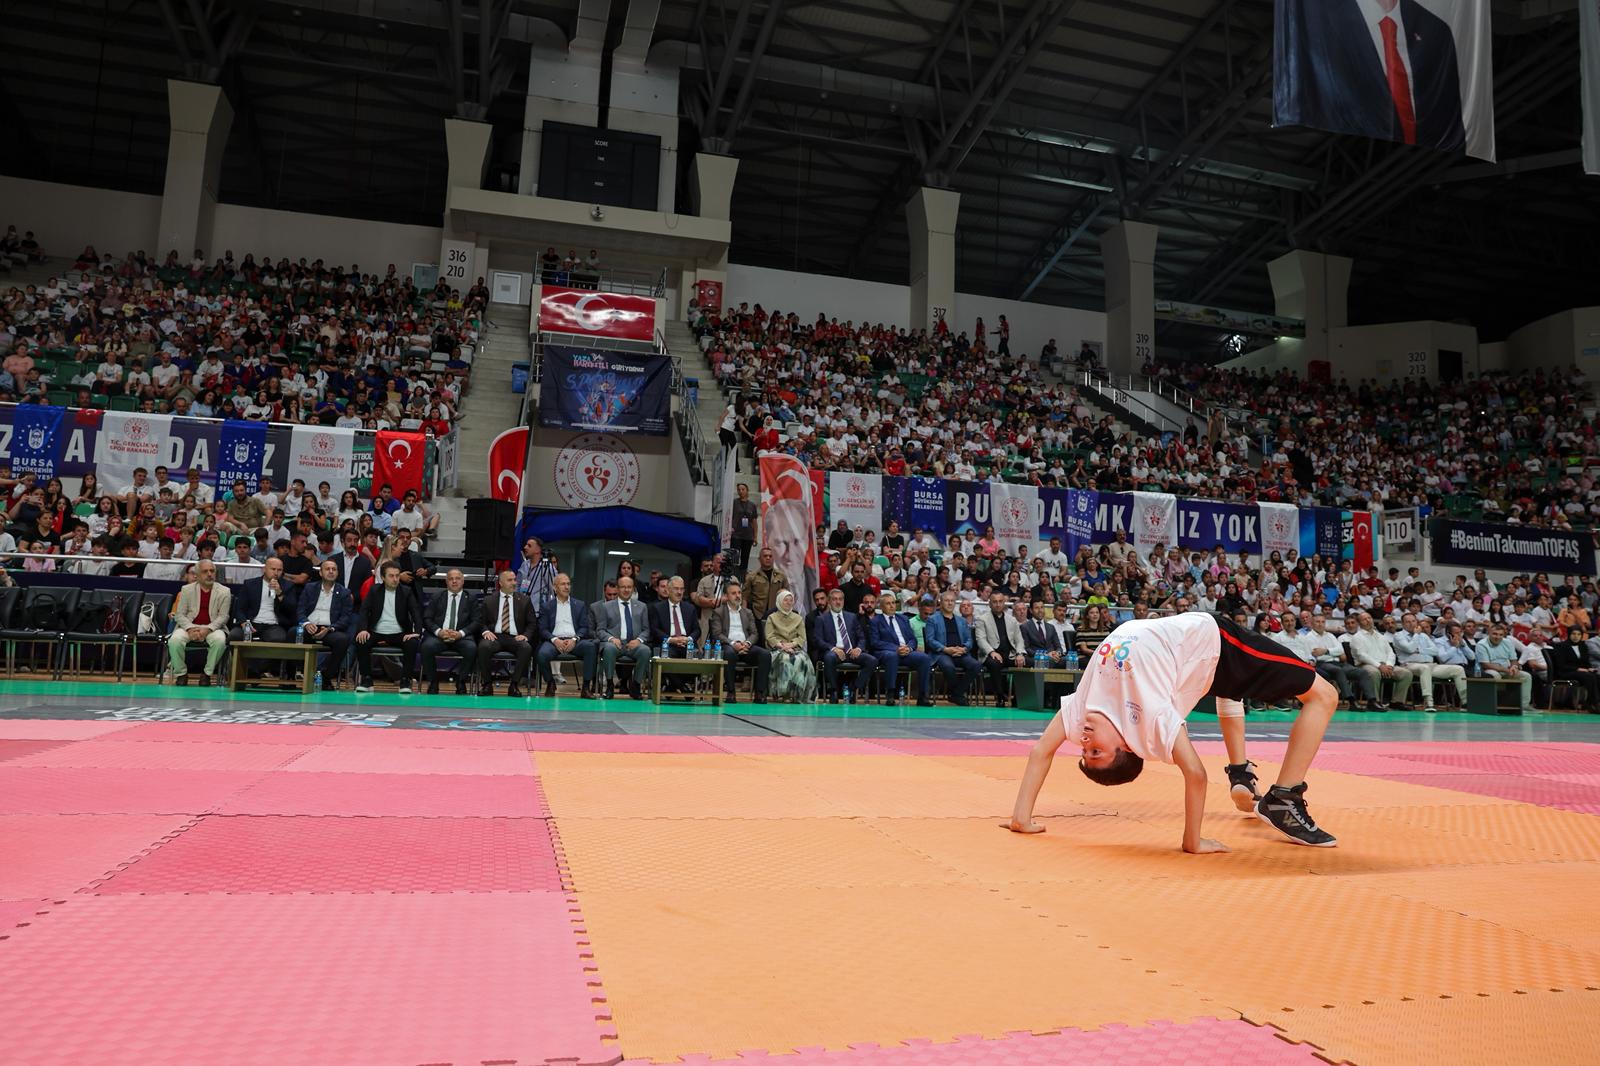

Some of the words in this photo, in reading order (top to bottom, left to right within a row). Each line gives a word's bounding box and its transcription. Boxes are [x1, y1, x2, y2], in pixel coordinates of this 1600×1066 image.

[449, 250, 466, 262] 316
[447, 265, 464, 278] 210
[933, 307, 946, 318] 317
[1136, 334, 1149, 344] 319
[1136, 346, 1150, 357] 212
[1408, 352, 1426, 362] 320
[1409, 364, 1426, 375] 213
[1114, 392, 1127, 403] 318
[13, 457, 54, 467] BURSA
[220, 471, 257, 480] BURSA
[914, 491, 943, 500] BURSA
[1068, 516, 1091, 528] BURSA
[1213, 513, 1257, 542] YOK
[1388, 522, 1407, 539] 110
[1451, 530, 1580, 564] #BenimTakımımTOFAŞ
